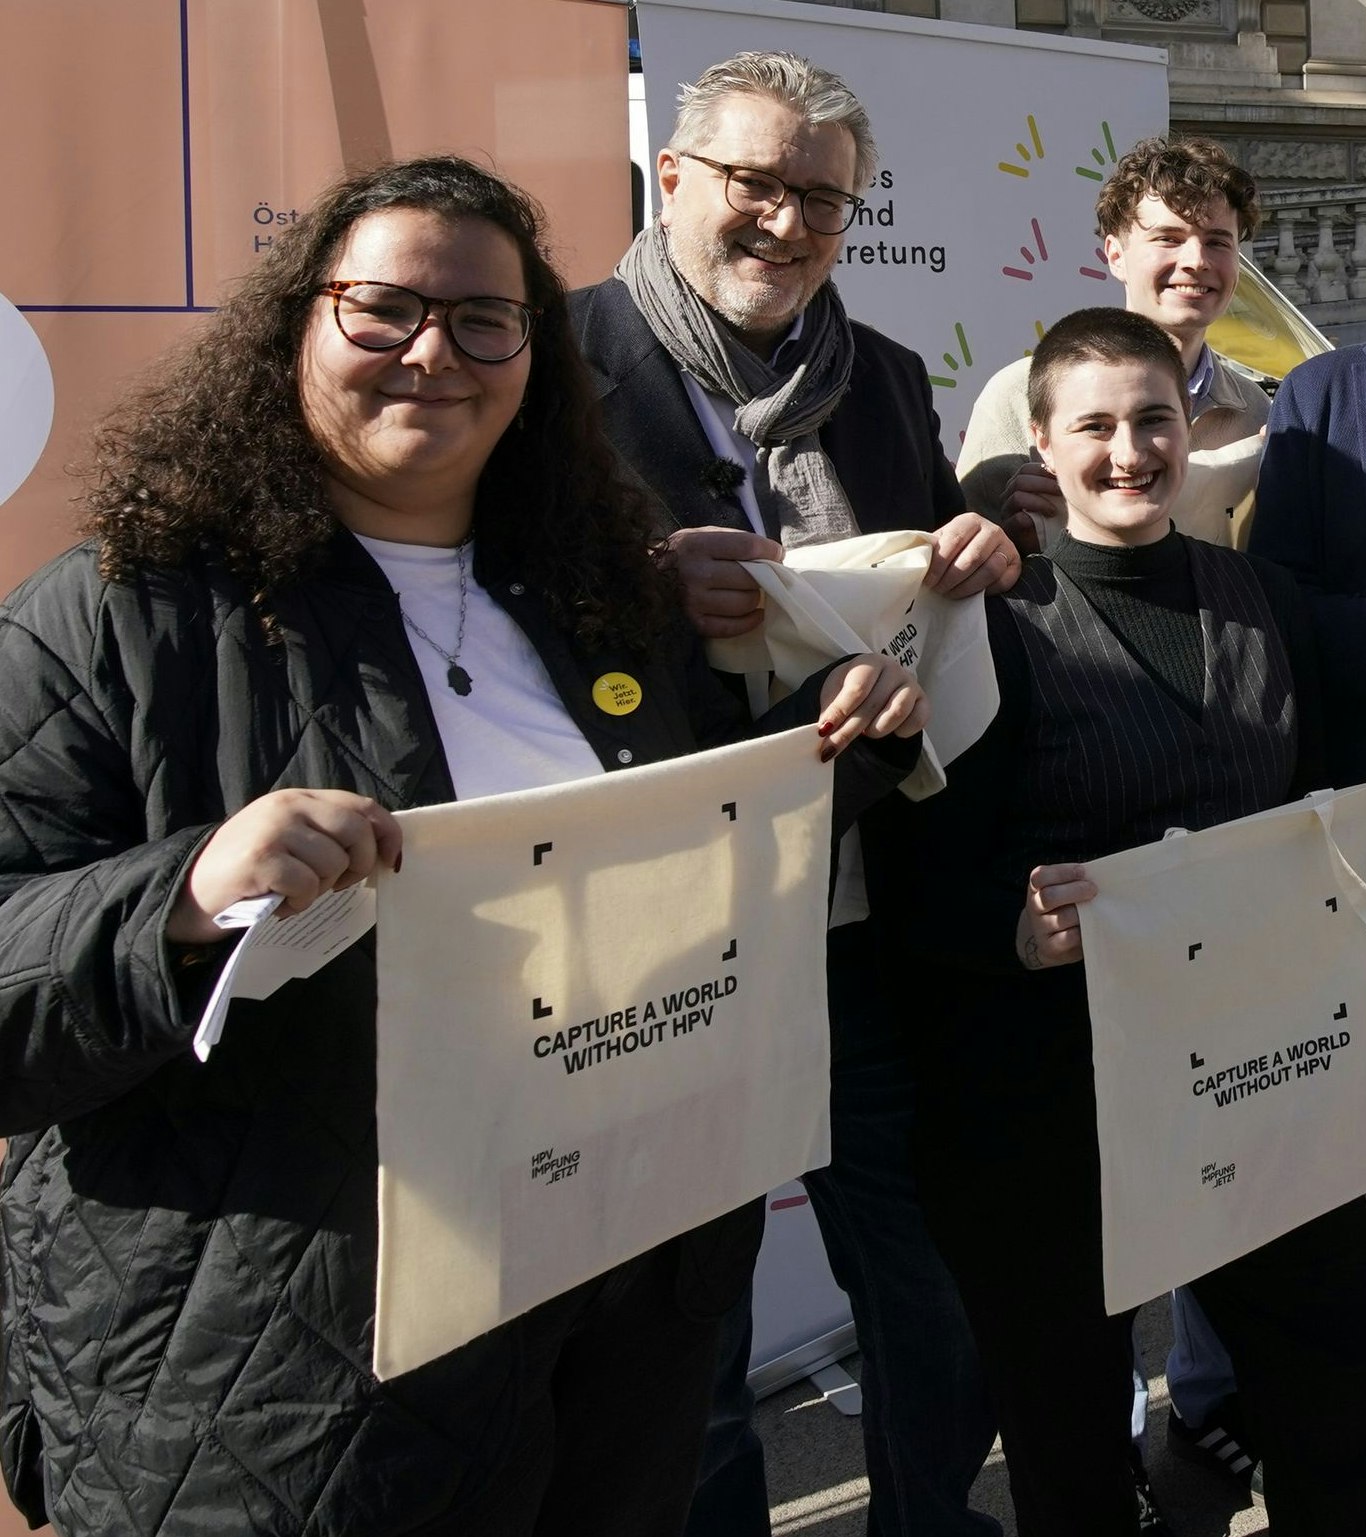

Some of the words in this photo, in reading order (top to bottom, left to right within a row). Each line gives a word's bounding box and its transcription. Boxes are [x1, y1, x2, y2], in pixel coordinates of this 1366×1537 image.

[253, 201, 300, 226] Öst
[858, 199, 894, 226] nd
[888, 623, 918, 657] WORLD
[533, 1006, 637, 1059] CAPTURE
[642, 1001, 657, 1023] A
[662, 974, 738, 1016] WORLD
[563, 1021, 667, 1075] WITHOUT
[672, 1005, 714, 1038] HPV
[1192, 1055, 1269, 1097] CAPTURE
[1272, 1051, 1284, 1068] A
[1286, 1031, 1351, 1062] WORLD
[1214, 1065, 1292, 1108] WITHOUT
[1296, 1054, 1332, 1079] HPV
[531, 1148, 554, 1168] HPV
[531, 1150, 581, 1180] IMPFUNG
[1201, 1161, 1217, 1175] HPV
[1201, 1163, 1236, 1185] IMPFUNG
